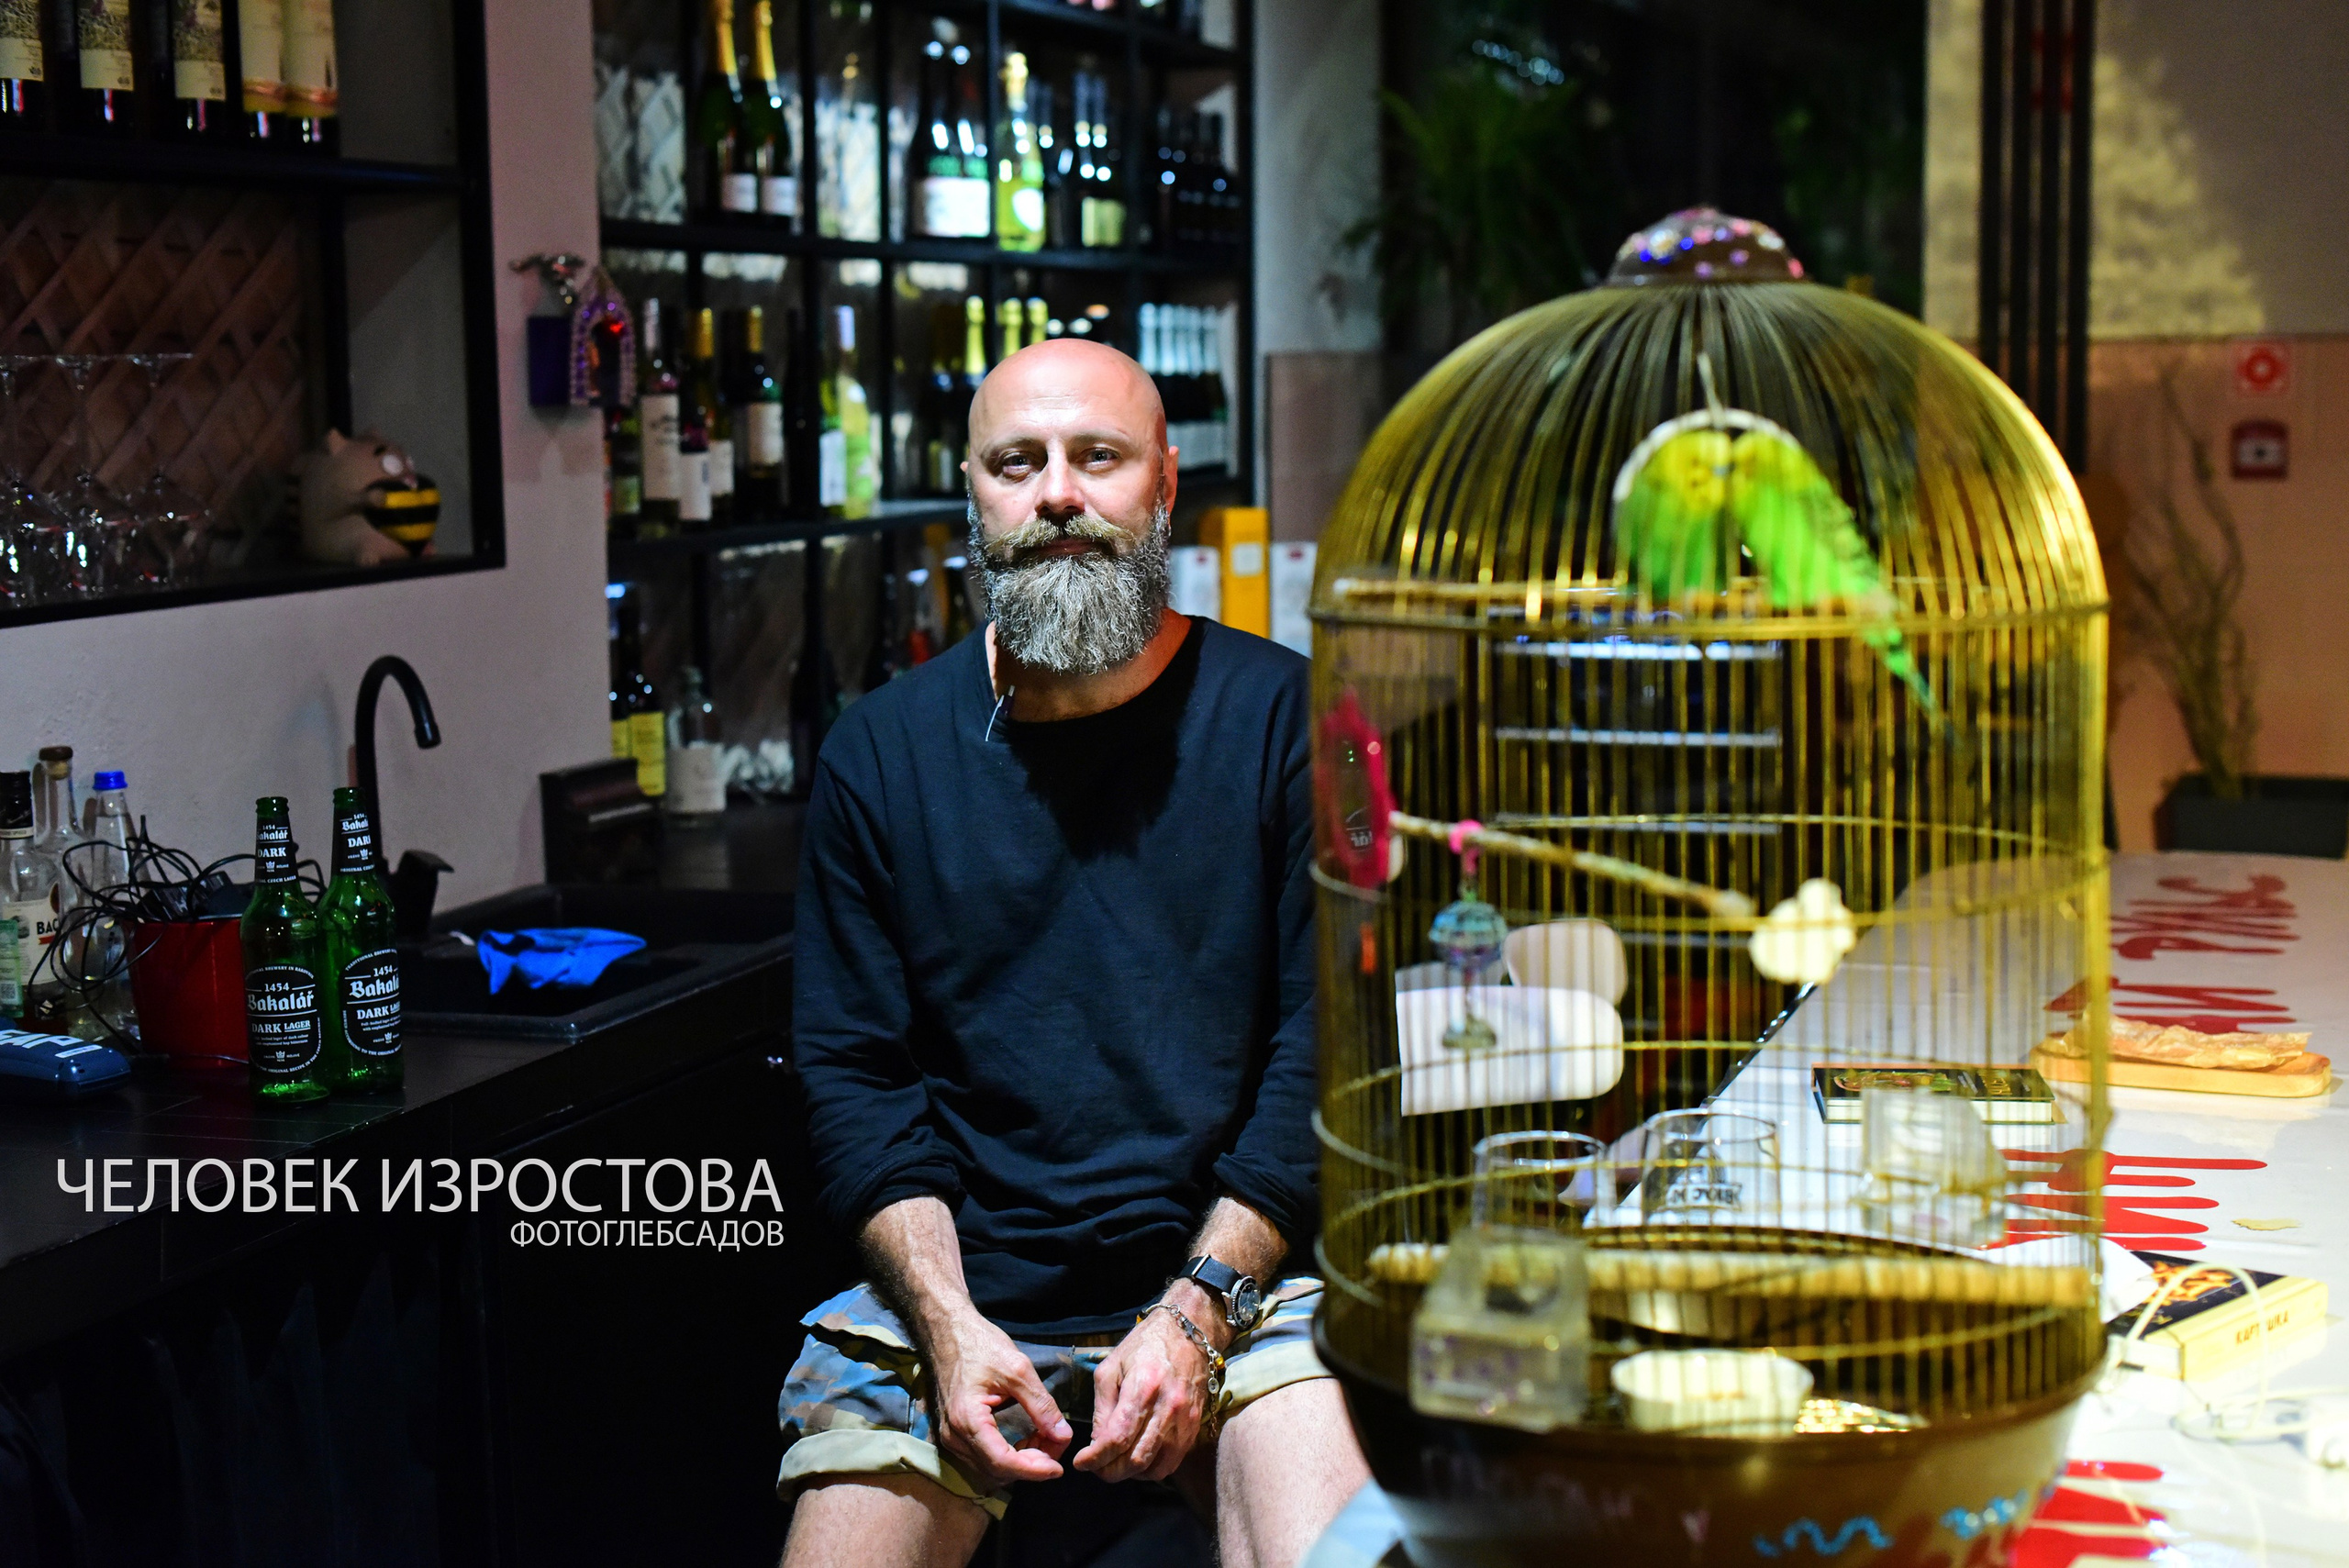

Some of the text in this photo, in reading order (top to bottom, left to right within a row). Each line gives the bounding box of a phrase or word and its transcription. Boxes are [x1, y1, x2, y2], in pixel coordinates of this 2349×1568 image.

[257, 847, 286, 858] DARK
[373, 964, 393, 977] 1454
[264, 982, 289, 992] 1454
[247, 990, 314, 1011] Bakalář
[356, 1006, 389, 1020] DARK
[251, 1019, 311, 1033] DARK LAGER
[2235, 1309, 2288, 1345] КАРТШКА
